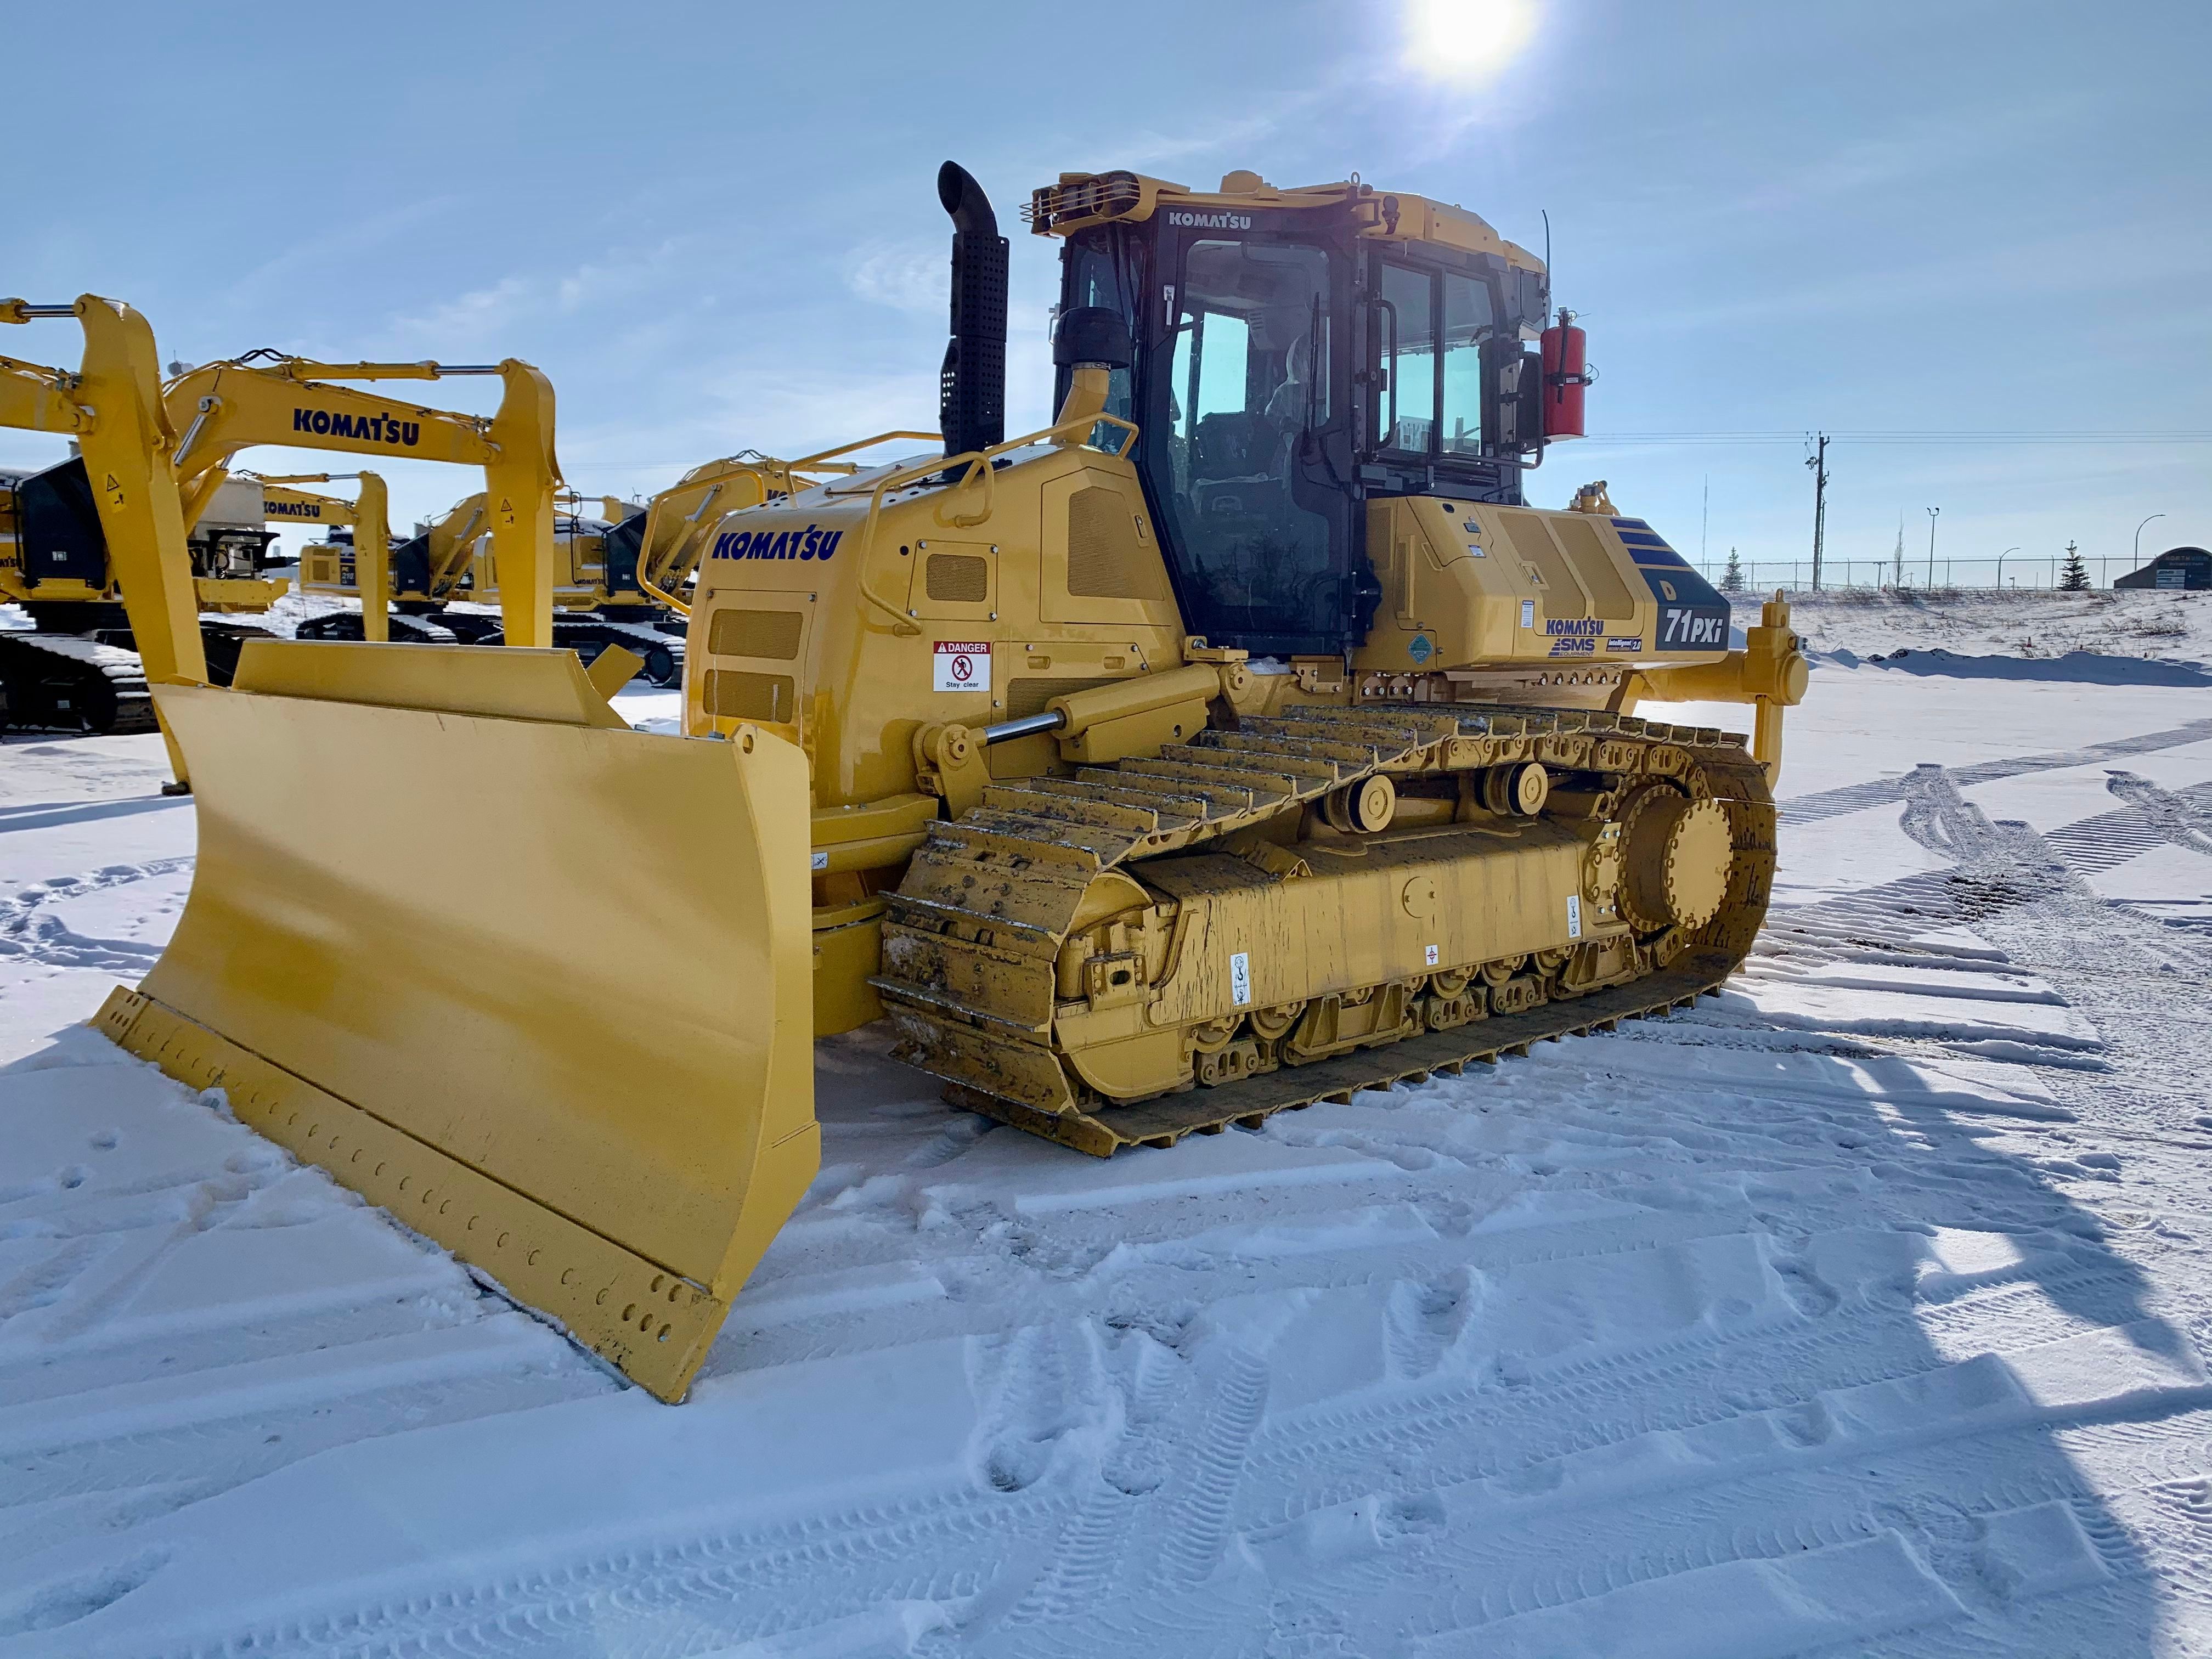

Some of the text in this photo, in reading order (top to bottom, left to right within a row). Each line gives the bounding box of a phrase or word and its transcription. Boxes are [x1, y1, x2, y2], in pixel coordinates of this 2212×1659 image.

[1169, 212, 1251, 229] KOMATSU
[294, 408, 419, 446] KOMATSU
[711, 524, 844, 561] KOMATSU
[1546, 616, 1604, 635] KOMATSU
[948, 643, 987, 653] DANGER
[1560, 638, 1595, 651] SMS
[1608, 639, 1632, 647] intelligent
